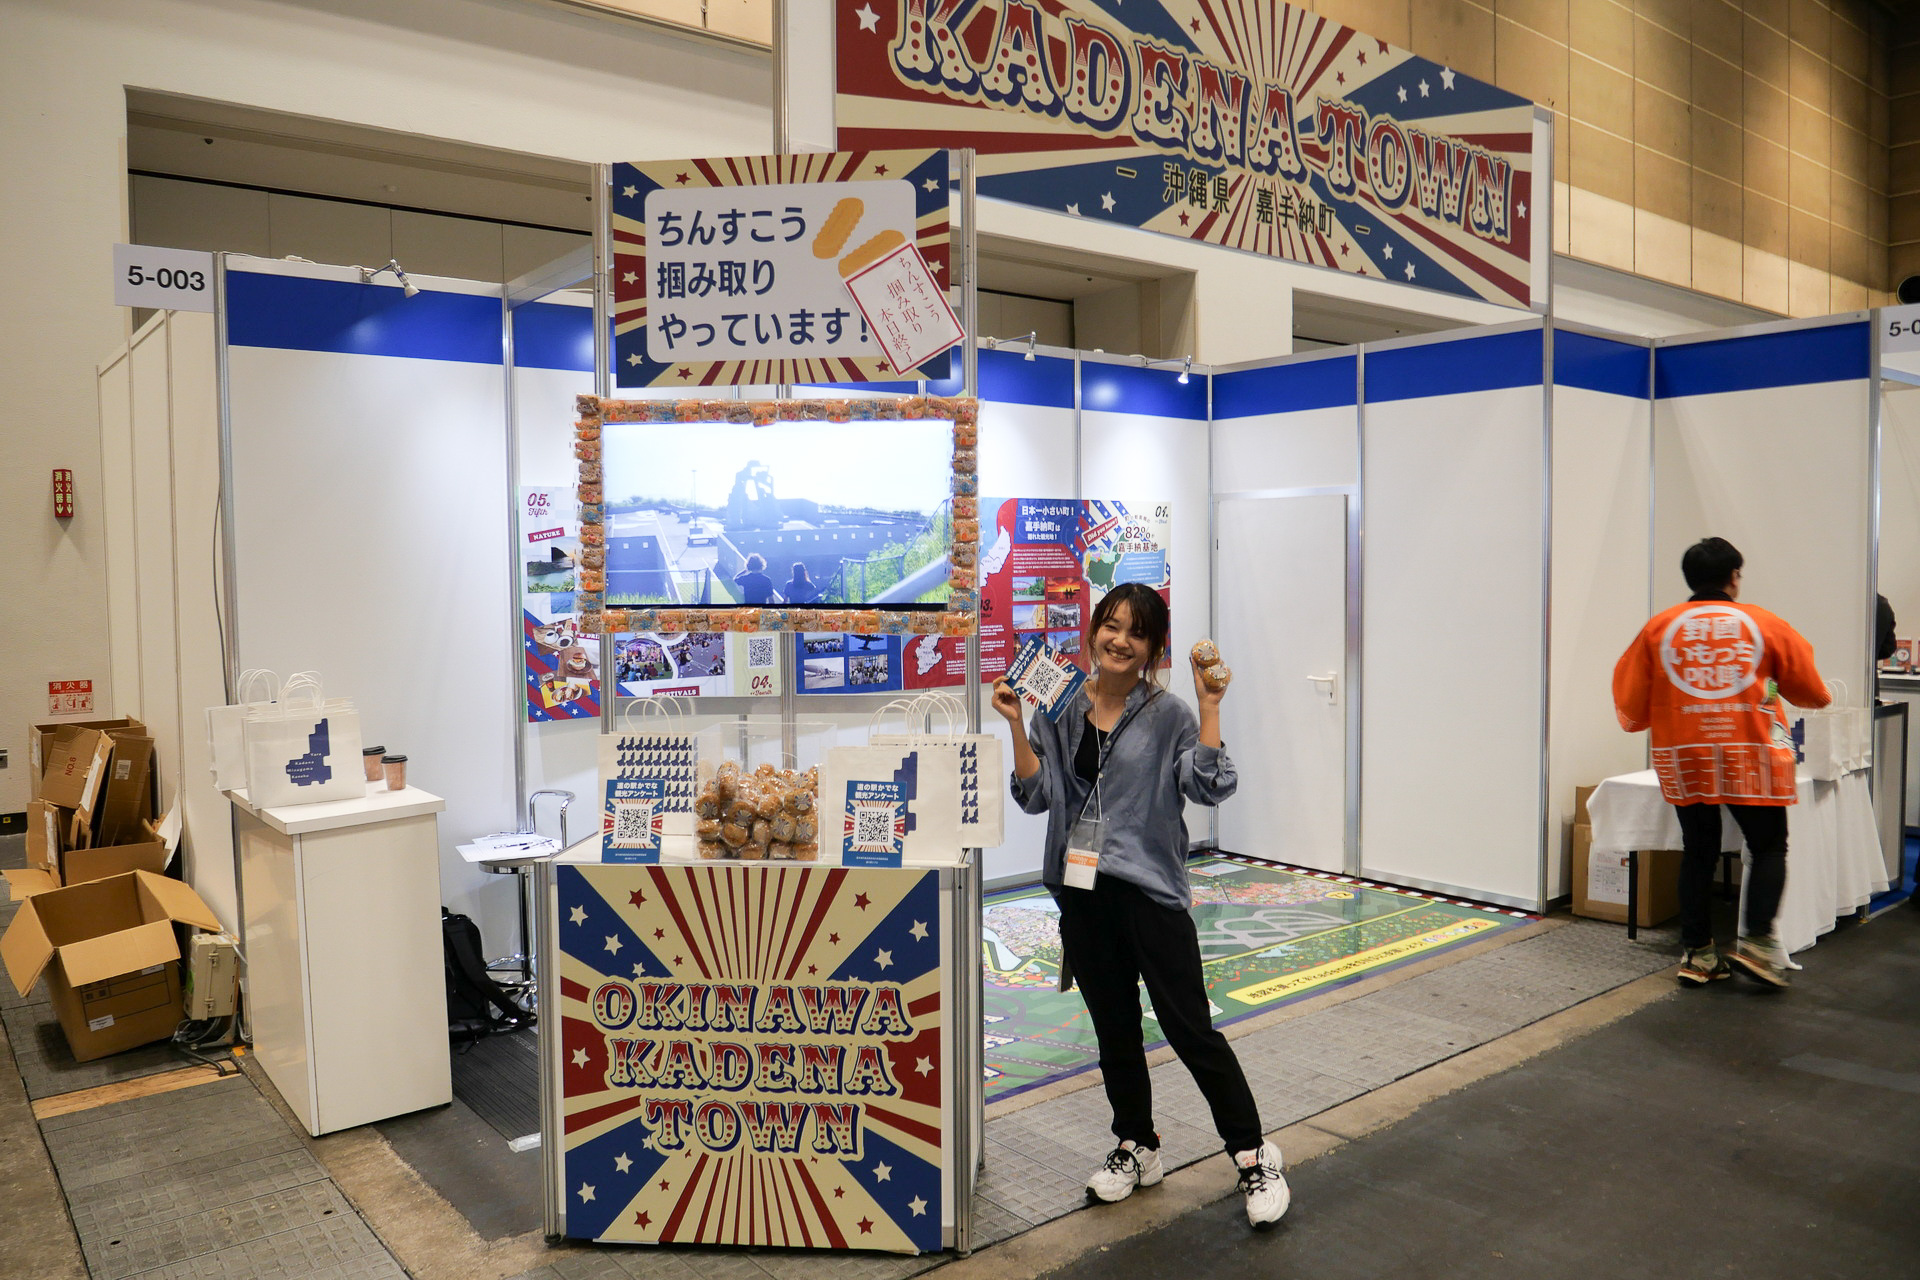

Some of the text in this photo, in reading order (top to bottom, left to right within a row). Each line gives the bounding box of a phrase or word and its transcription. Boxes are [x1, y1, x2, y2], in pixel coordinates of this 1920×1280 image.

[893, 0, 1513, 240] KADENA TOWN
[1163, 161, 1336, 239] 沖縄県 嘉手納町
[657, 206, 807, 247] ちんすこう
[127, 265, 206, 292] 5-003
[656, 259, 776, 299] 掴み取り
[899, 256, 941, 324] ちんすこう
[886, 278, 924, 335] 掴み取り
[657, 307, 870, 350] やっています！
[879, 307, 912, 363] 本日終了
[55, 471, 63, 504] 消火器
[1021, 505, 1075, 517] 日本一小さい町！
[533, 530, 561, 541] NATURE
[1118, 542, 1159, 553] 嘉手納基地
[1681, 616, 1742, 641] 野國
[52, 680, 89, 690] 消火器
[1683, 664, 1744, 688] PR隊
[614, 789, 659, 798] 観光アンケート
[616, 781, 659, 790] 道の駅かでな
[854, 791, 900, 801] 観光アンケート
[856, 783, 900, 793] 道の駅かでな
[592, 981, 914, 1036] OKINAWA
[609, 1037, 899, 1096] KADENA
[645, 1097, 862, 1155] TOWN
